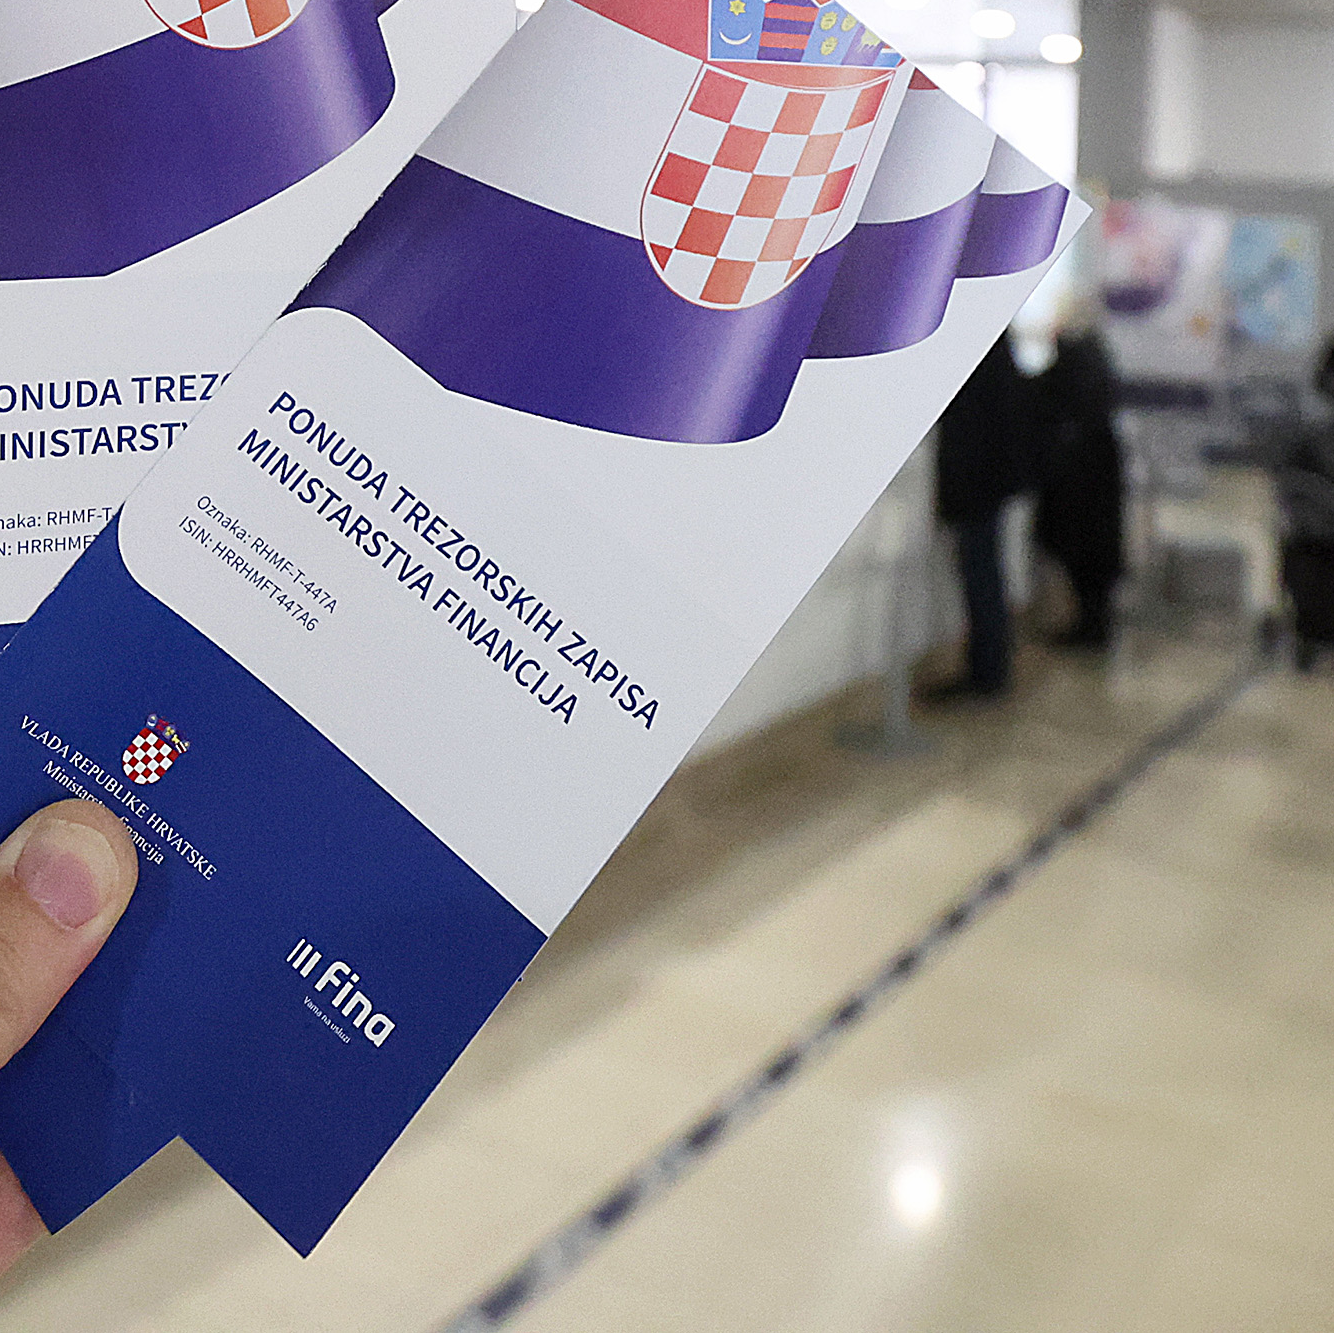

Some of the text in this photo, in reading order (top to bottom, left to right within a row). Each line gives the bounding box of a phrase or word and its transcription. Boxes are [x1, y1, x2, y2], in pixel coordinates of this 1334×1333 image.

[178, 516, 319, 631] ISIN: HRRHMFT447A6
[197, 496, 337, 614] Oznaka: RHMF-T-447A
[237, 428, 578, 724] MINISTARSTVA FINANCIJA
[268, 391, 659, 730] PONUDA TREZORSKIH ZAPISA
[20, 715, 217, 881] VLADA REPUBLIKE HRVATSKE
